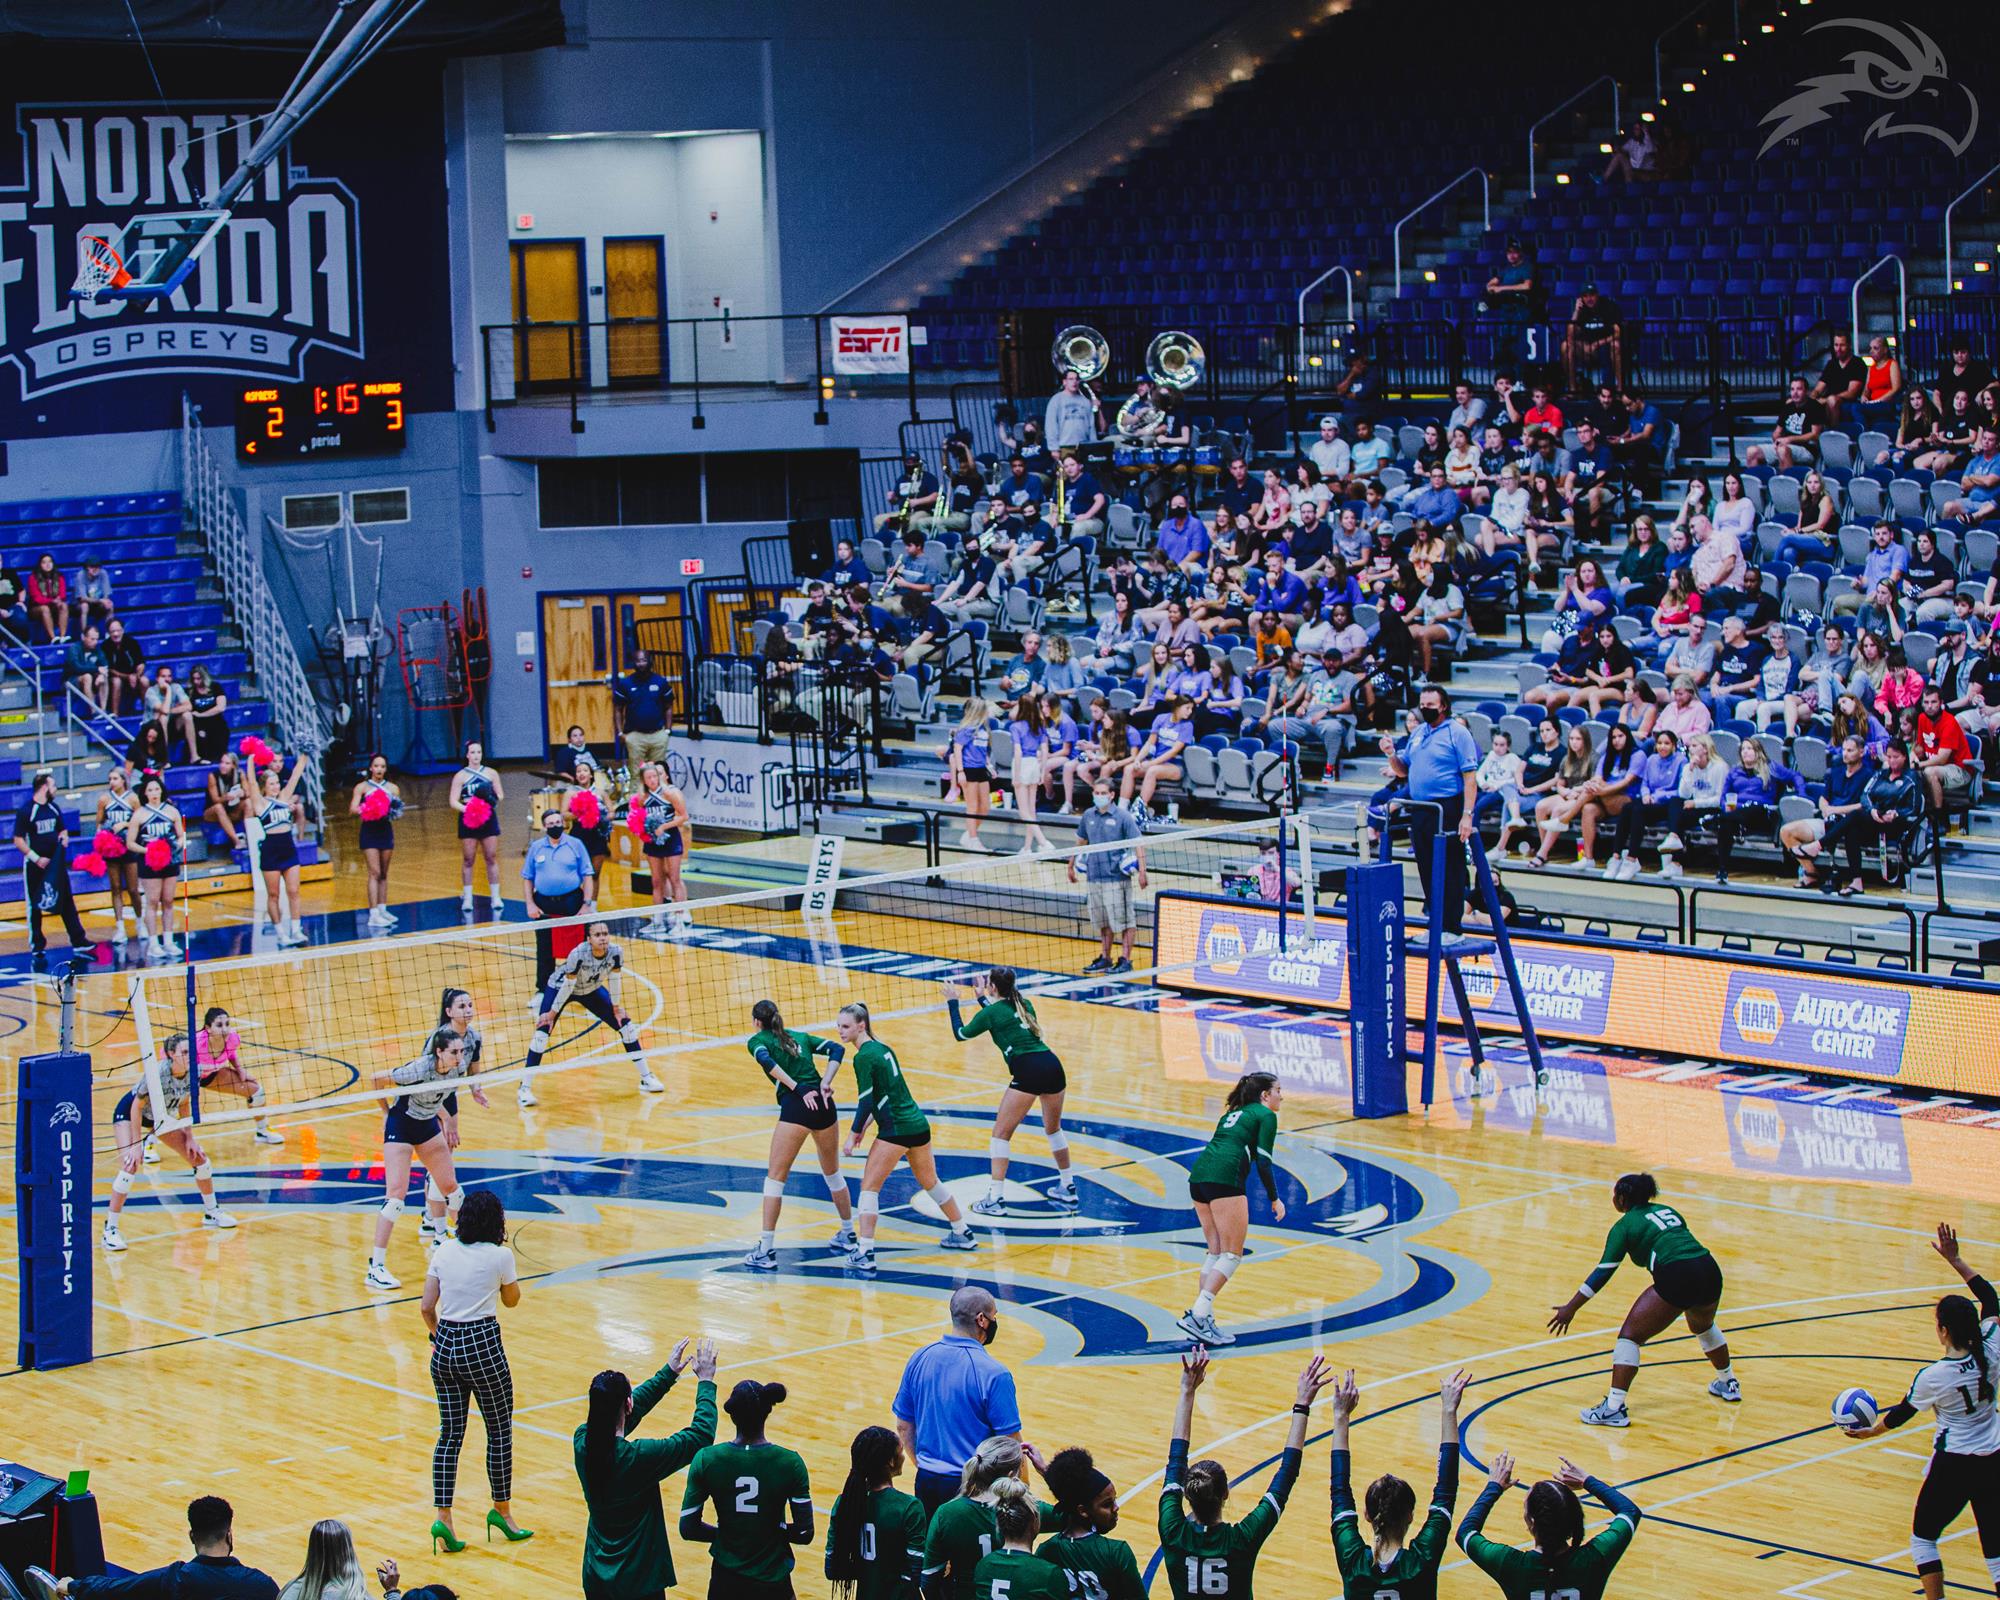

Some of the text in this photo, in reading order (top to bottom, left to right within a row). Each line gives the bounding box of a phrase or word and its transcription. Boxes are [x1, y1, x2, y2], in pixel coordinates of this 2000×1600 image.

[31, 115, 281, 208] NORTH
[57, 330, 269, 364] OSPREYS
[838, 326, 902, 352] ESPN
[1526, 327, 1537, 360] 5
[314, 383, 360, 414] 1:15
[267, 407, 284, 437] 2
[386, 400, 402, 430] 3
[311, 433, 341, 449] period
[687, 756, 755, 799] VyStar
[809, 839, 835, 910] OSREYS
[1267, 960, 1321, 987] CENTER
[1385, 924, 1394, 1059] OSPREYS
[1525, 992, 1584, 1021] CENTER
[1740, 1001, 1779, 1031] NAPA
[1791, 992, 1901, 1036] AUTOCARE
[1810, 1028, 1876, 1060] CENTER
[1223, 1110, 1244, 1128] 9
[60, 1130, 73, 1295] OSPREYS
[1644, 1208, 1683, 1231] 15
[735, 1475, 759, 1513] 2
[1185, 1556, 1229, 1595] 16
